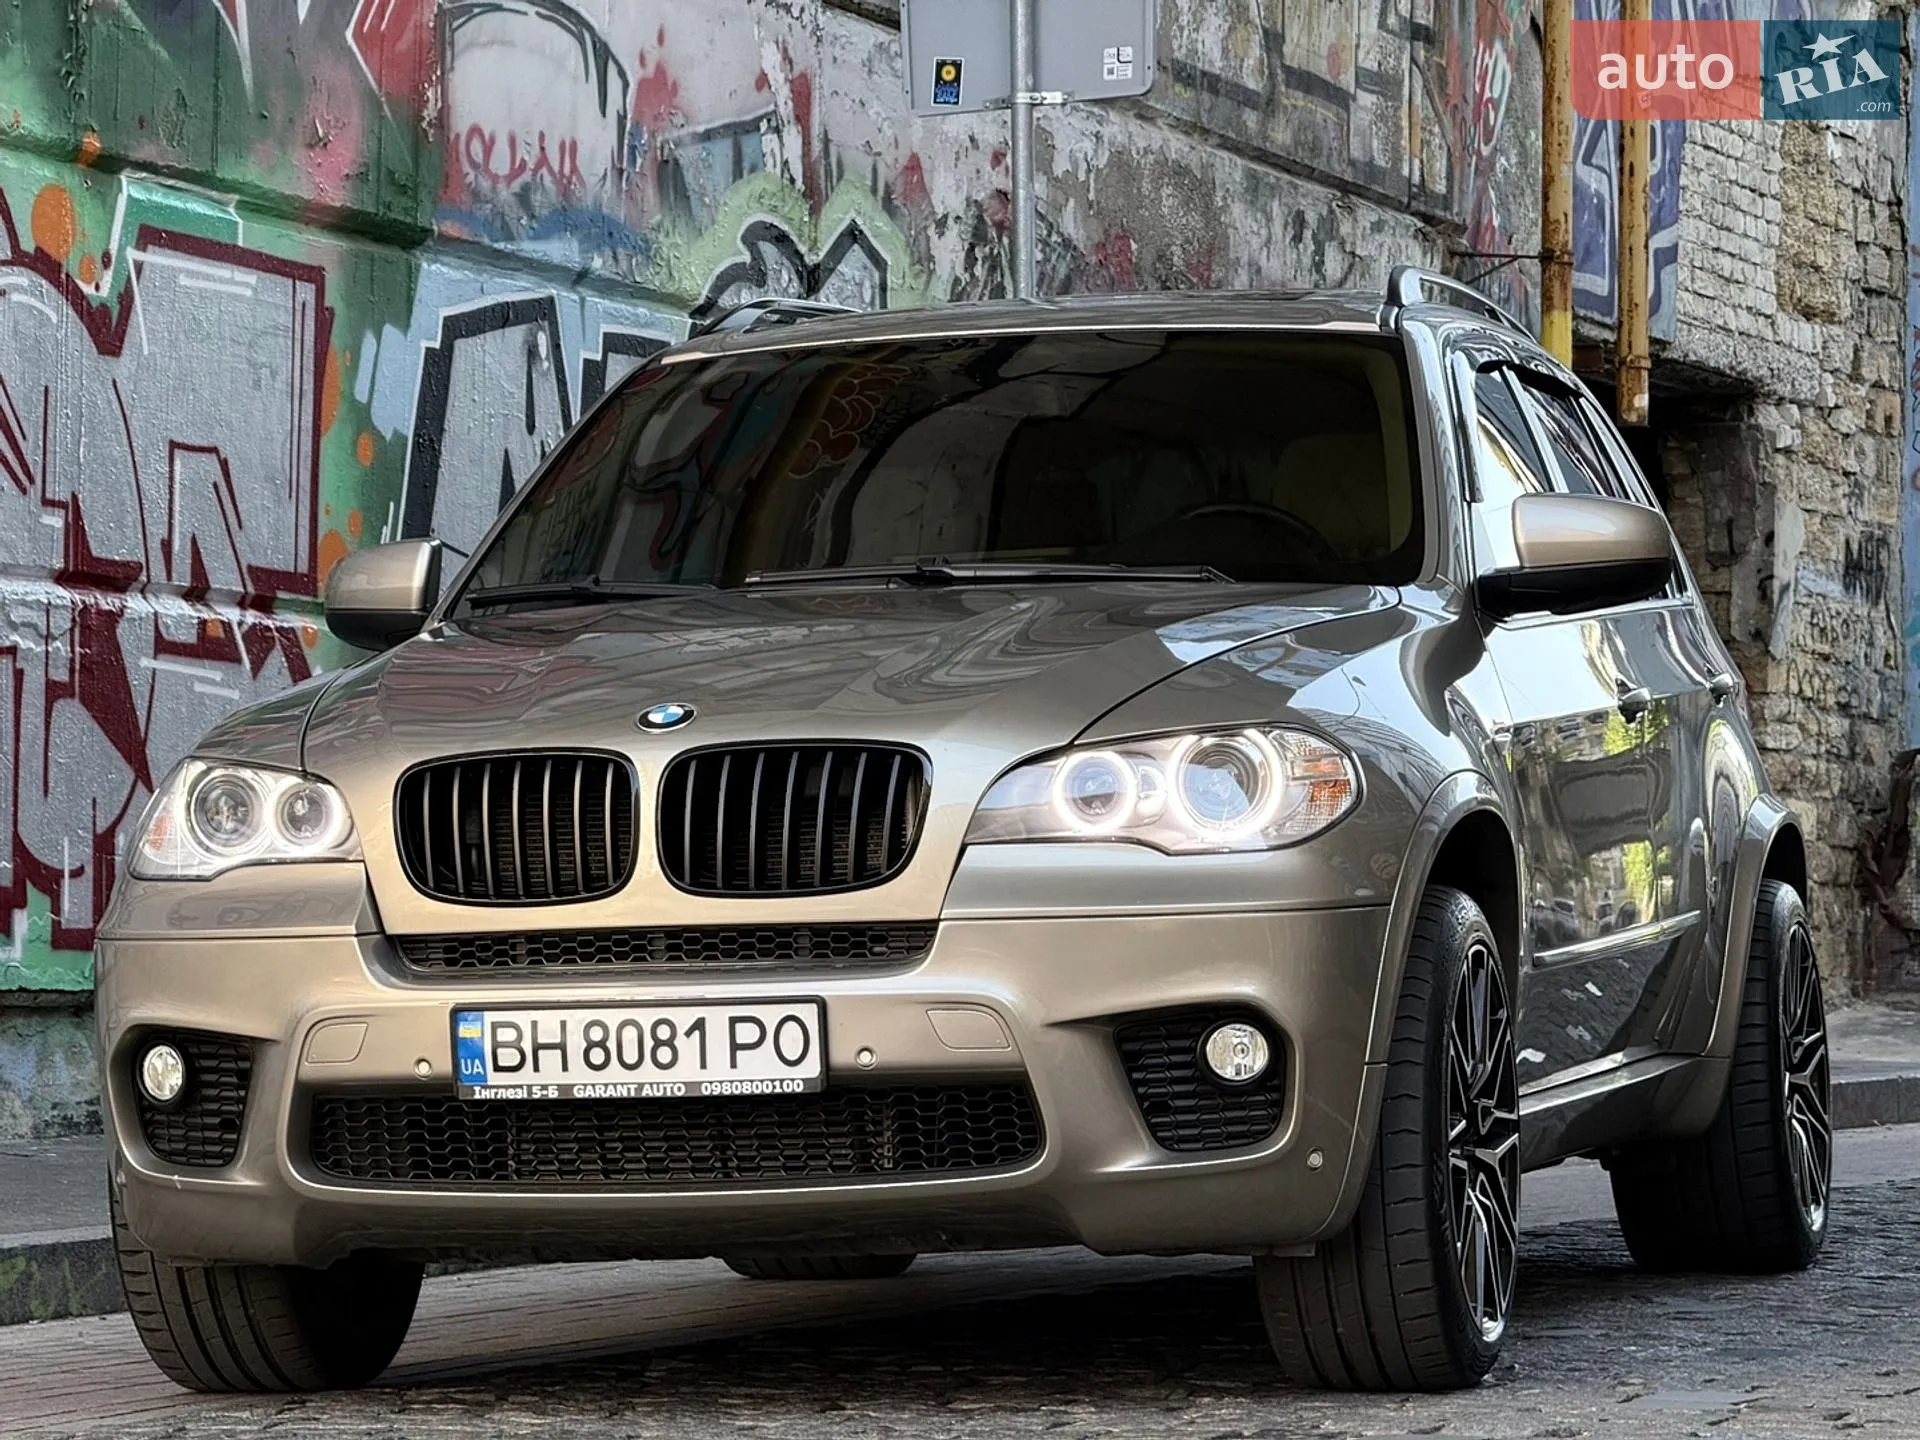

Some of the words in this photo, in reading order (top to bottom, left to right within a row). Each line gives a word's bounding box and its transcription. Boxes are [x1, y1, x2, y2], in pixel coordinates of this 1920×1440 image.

[490, 1019, 570, 1074] BH
[582, 1016, 708, 1072] 8081
[728, 1013, 811, 1070] PO
[461, 1058, 485, 1075] UA
[473, 1085, 528, 1099] Інглезі
[531, 1085, 559, 1099] 5-Б
[573, 1083, 639, 1099] GARANT
[641, 1082, 686, 1097] AUTO
[700, 1079, 804, 1096] 0980800100
